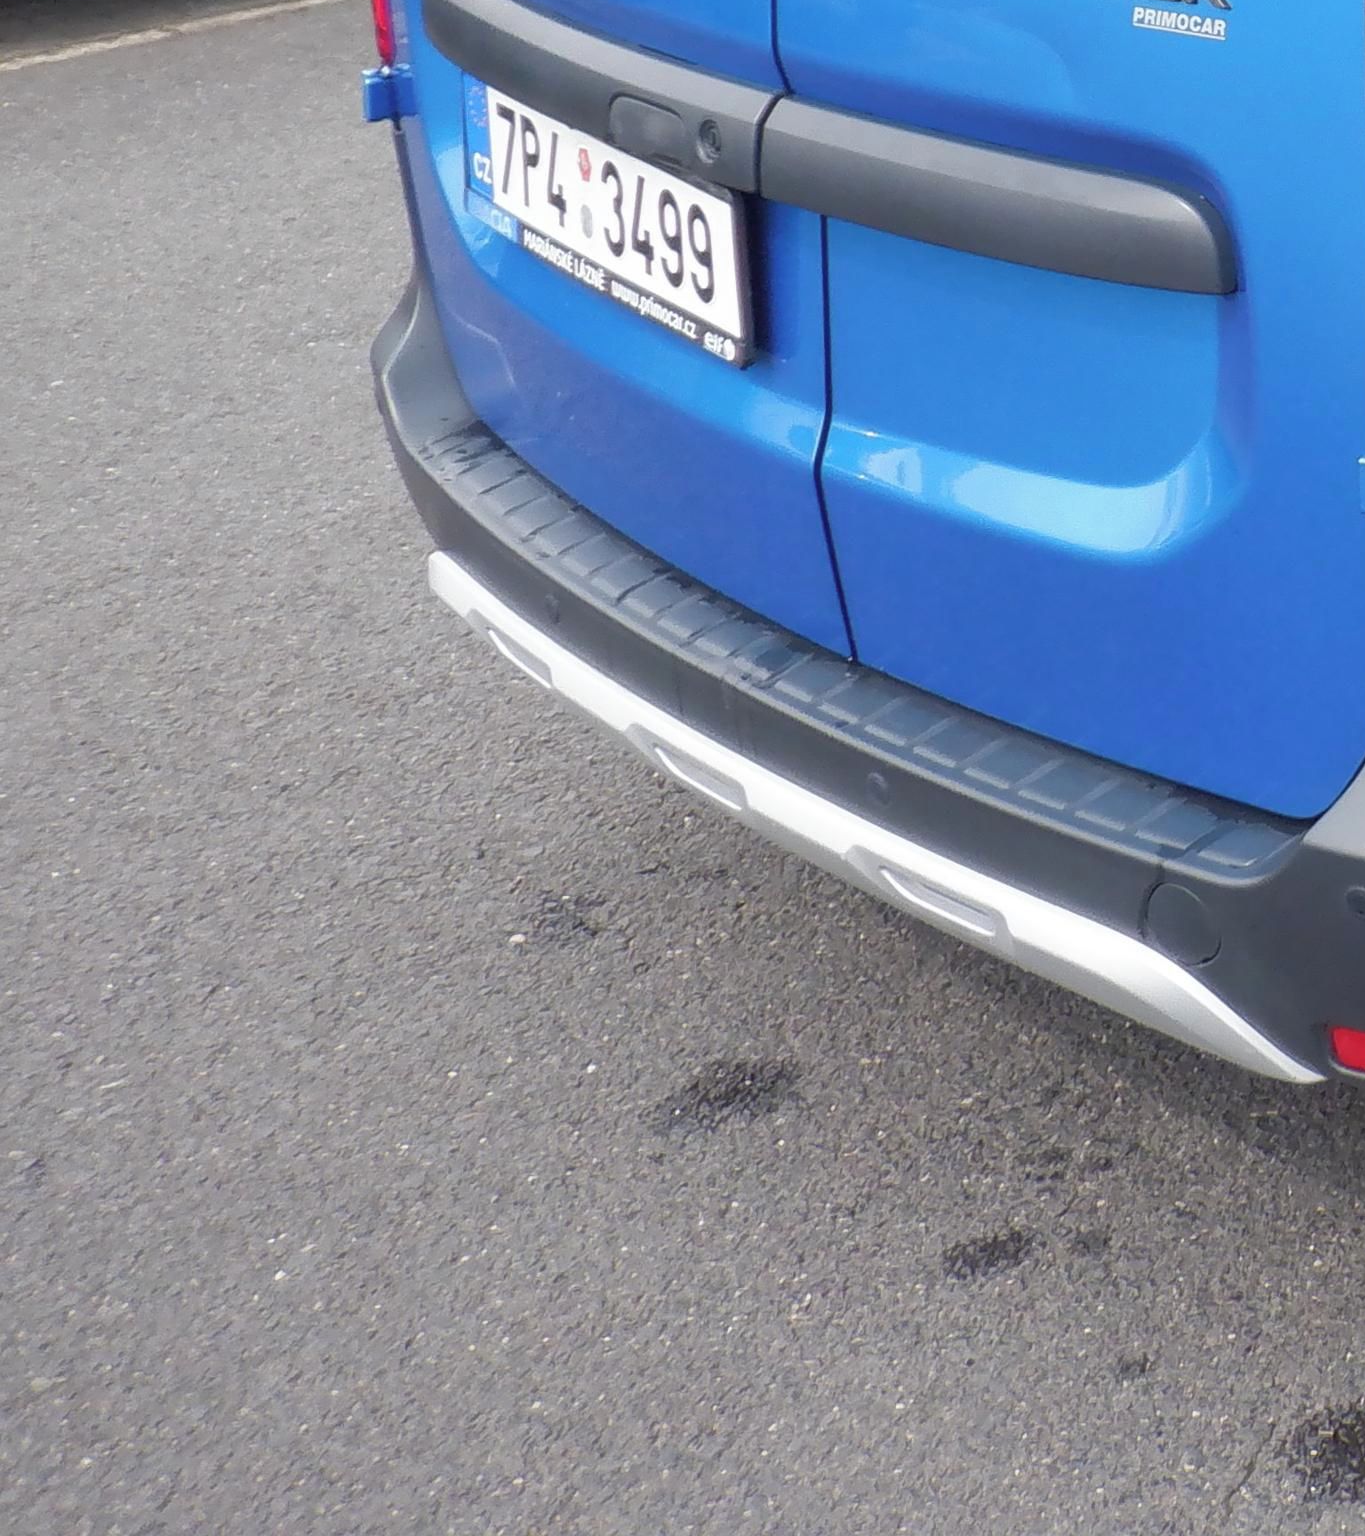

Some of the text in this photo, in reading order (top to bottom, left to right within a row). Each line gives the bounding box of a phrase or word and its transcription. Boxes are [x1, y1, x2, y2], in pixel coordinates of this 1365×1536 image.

[1133, 6, 1227, 38] PRIMOCAR
[472, 151, 493, 185] CZ
[495, 101, 715, 305] 7P4 3499
